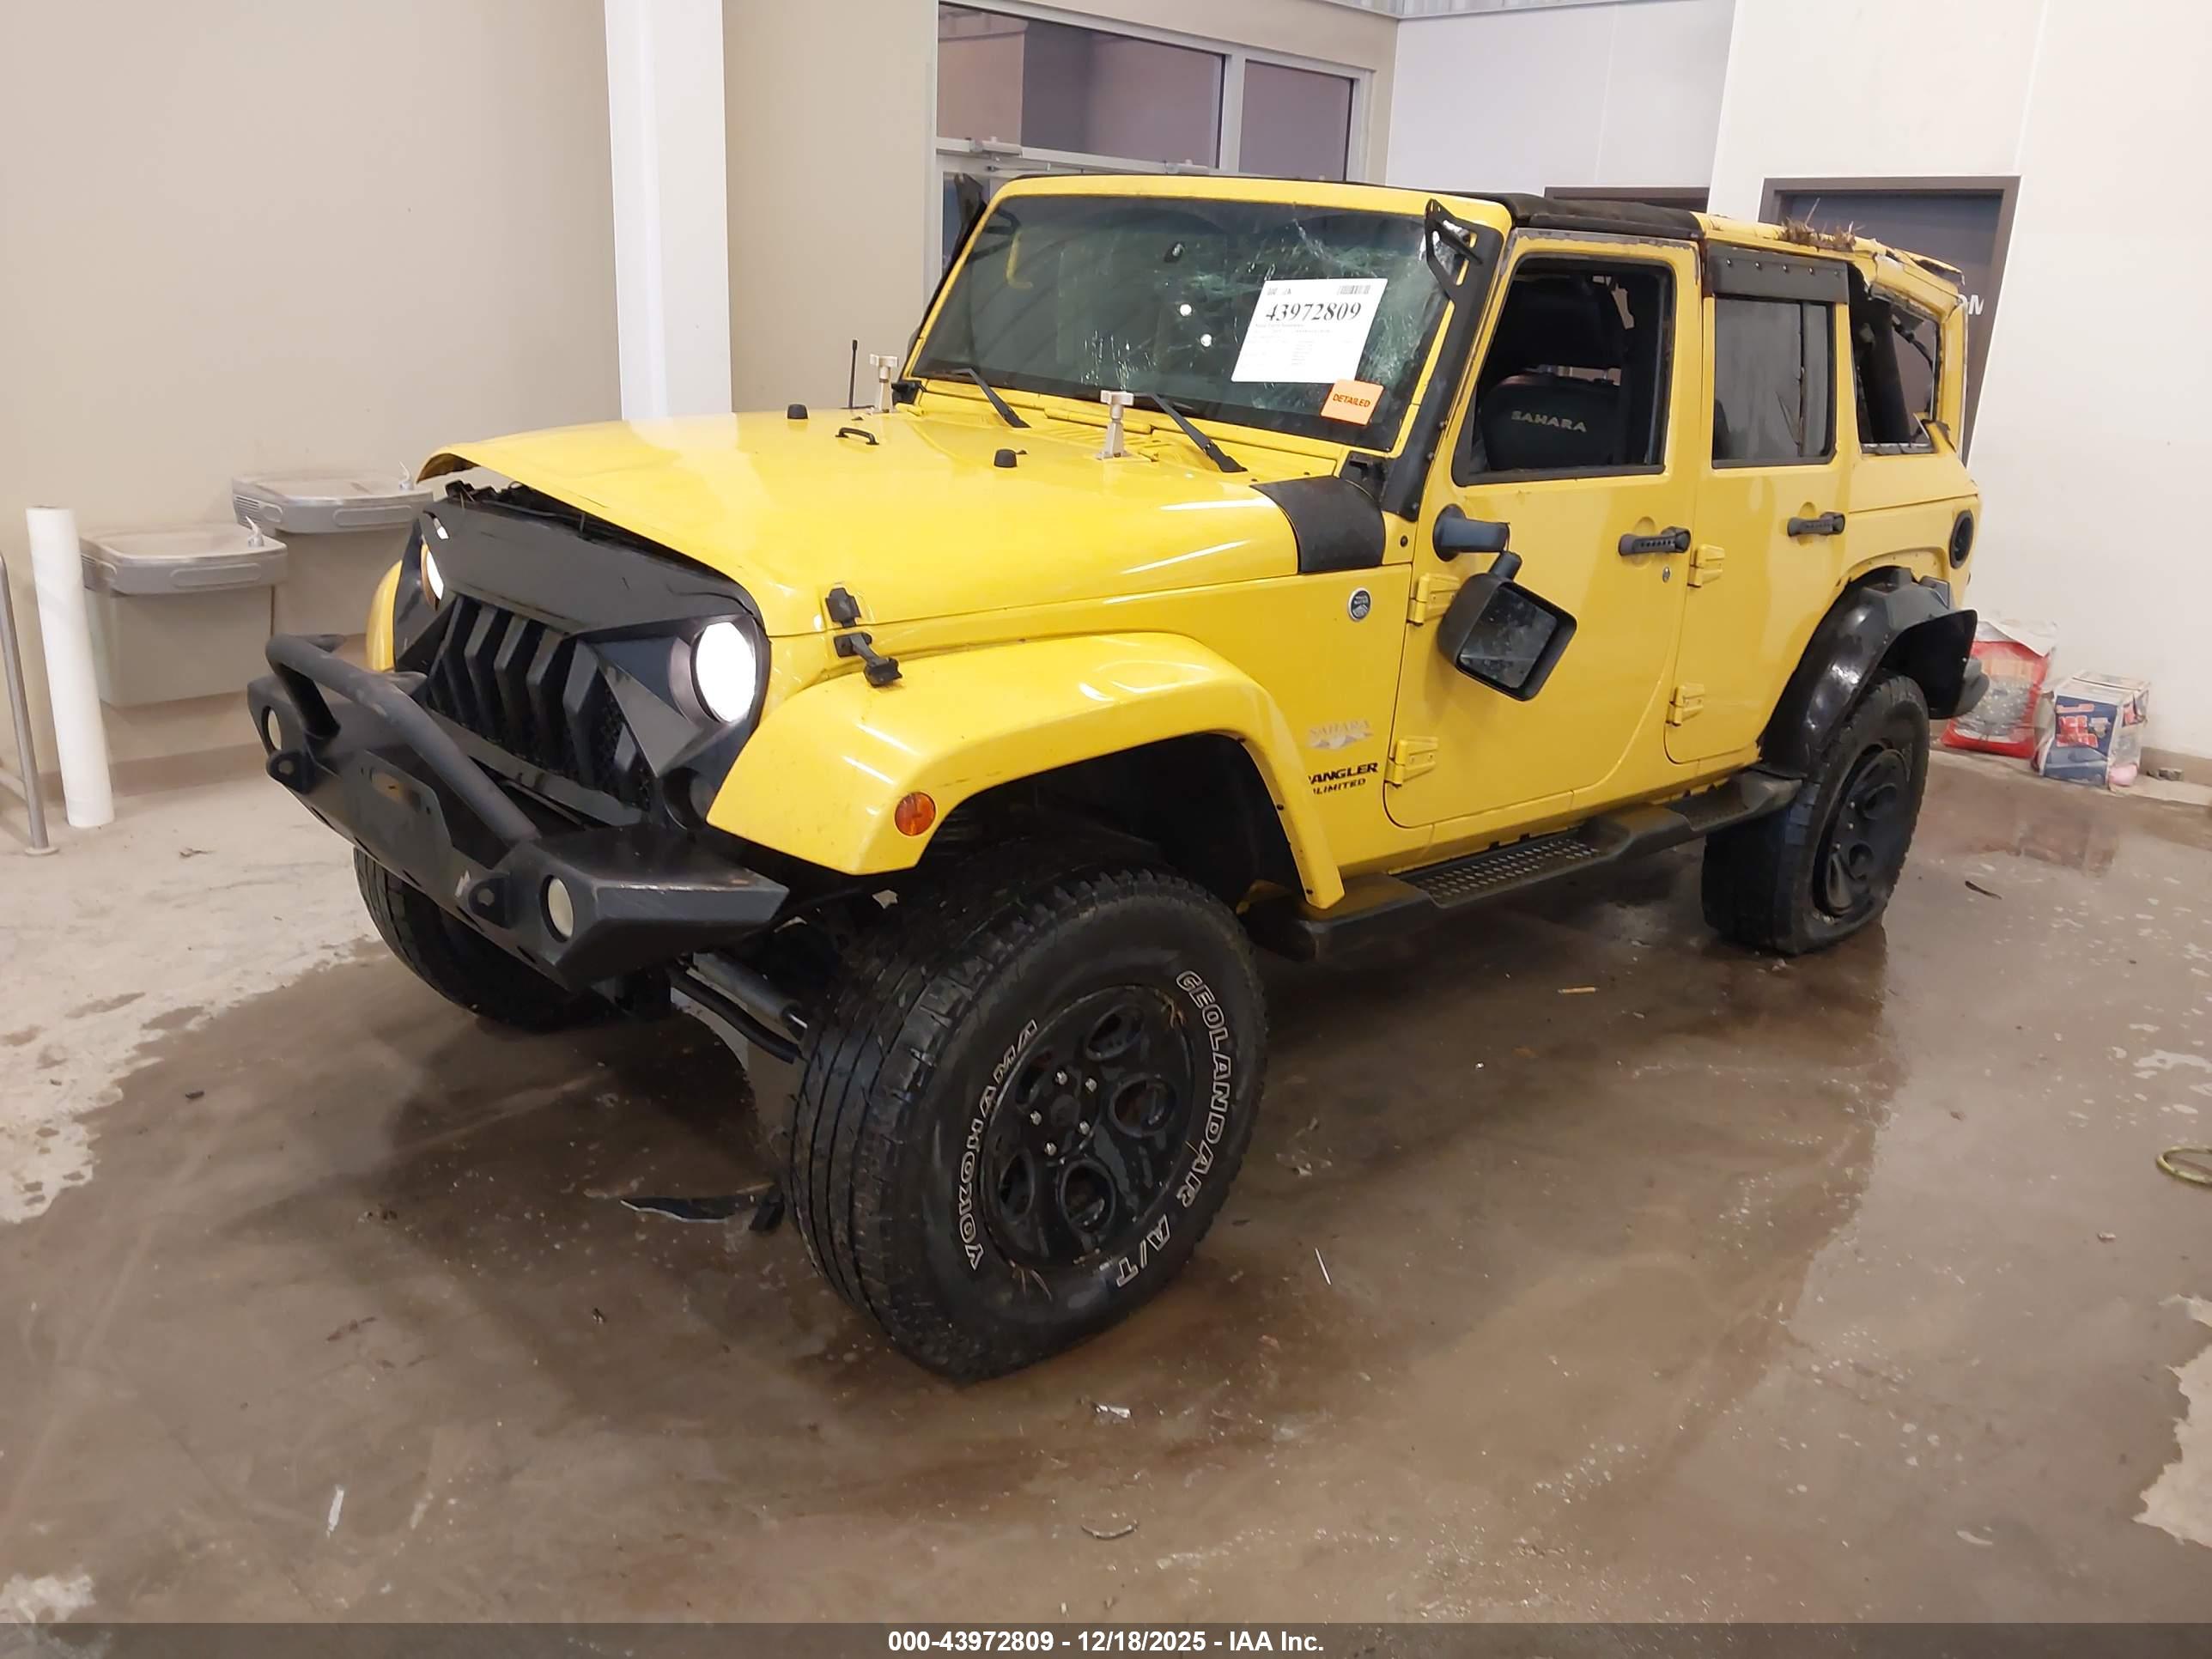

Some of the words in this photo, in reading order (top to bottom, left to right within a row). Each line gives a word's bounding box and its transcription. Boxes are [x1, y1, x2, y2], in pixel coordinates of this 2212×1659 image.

[1266, 301, 1362, 321] 43972809
[1333, 393, 1370, 408] DETAILED
[1511, 410, 1587, 433] SAHARA
[1308, 762, 1378, 785] ANGLER
[1313, 778, 1366, 795] LIMITED
[1175, 970, 1231, 1208] GEOLANDAR
[958, 1018, 1038, 1271] YOKOHAMA
[1116, 1213, 1171, 1288] A/T
